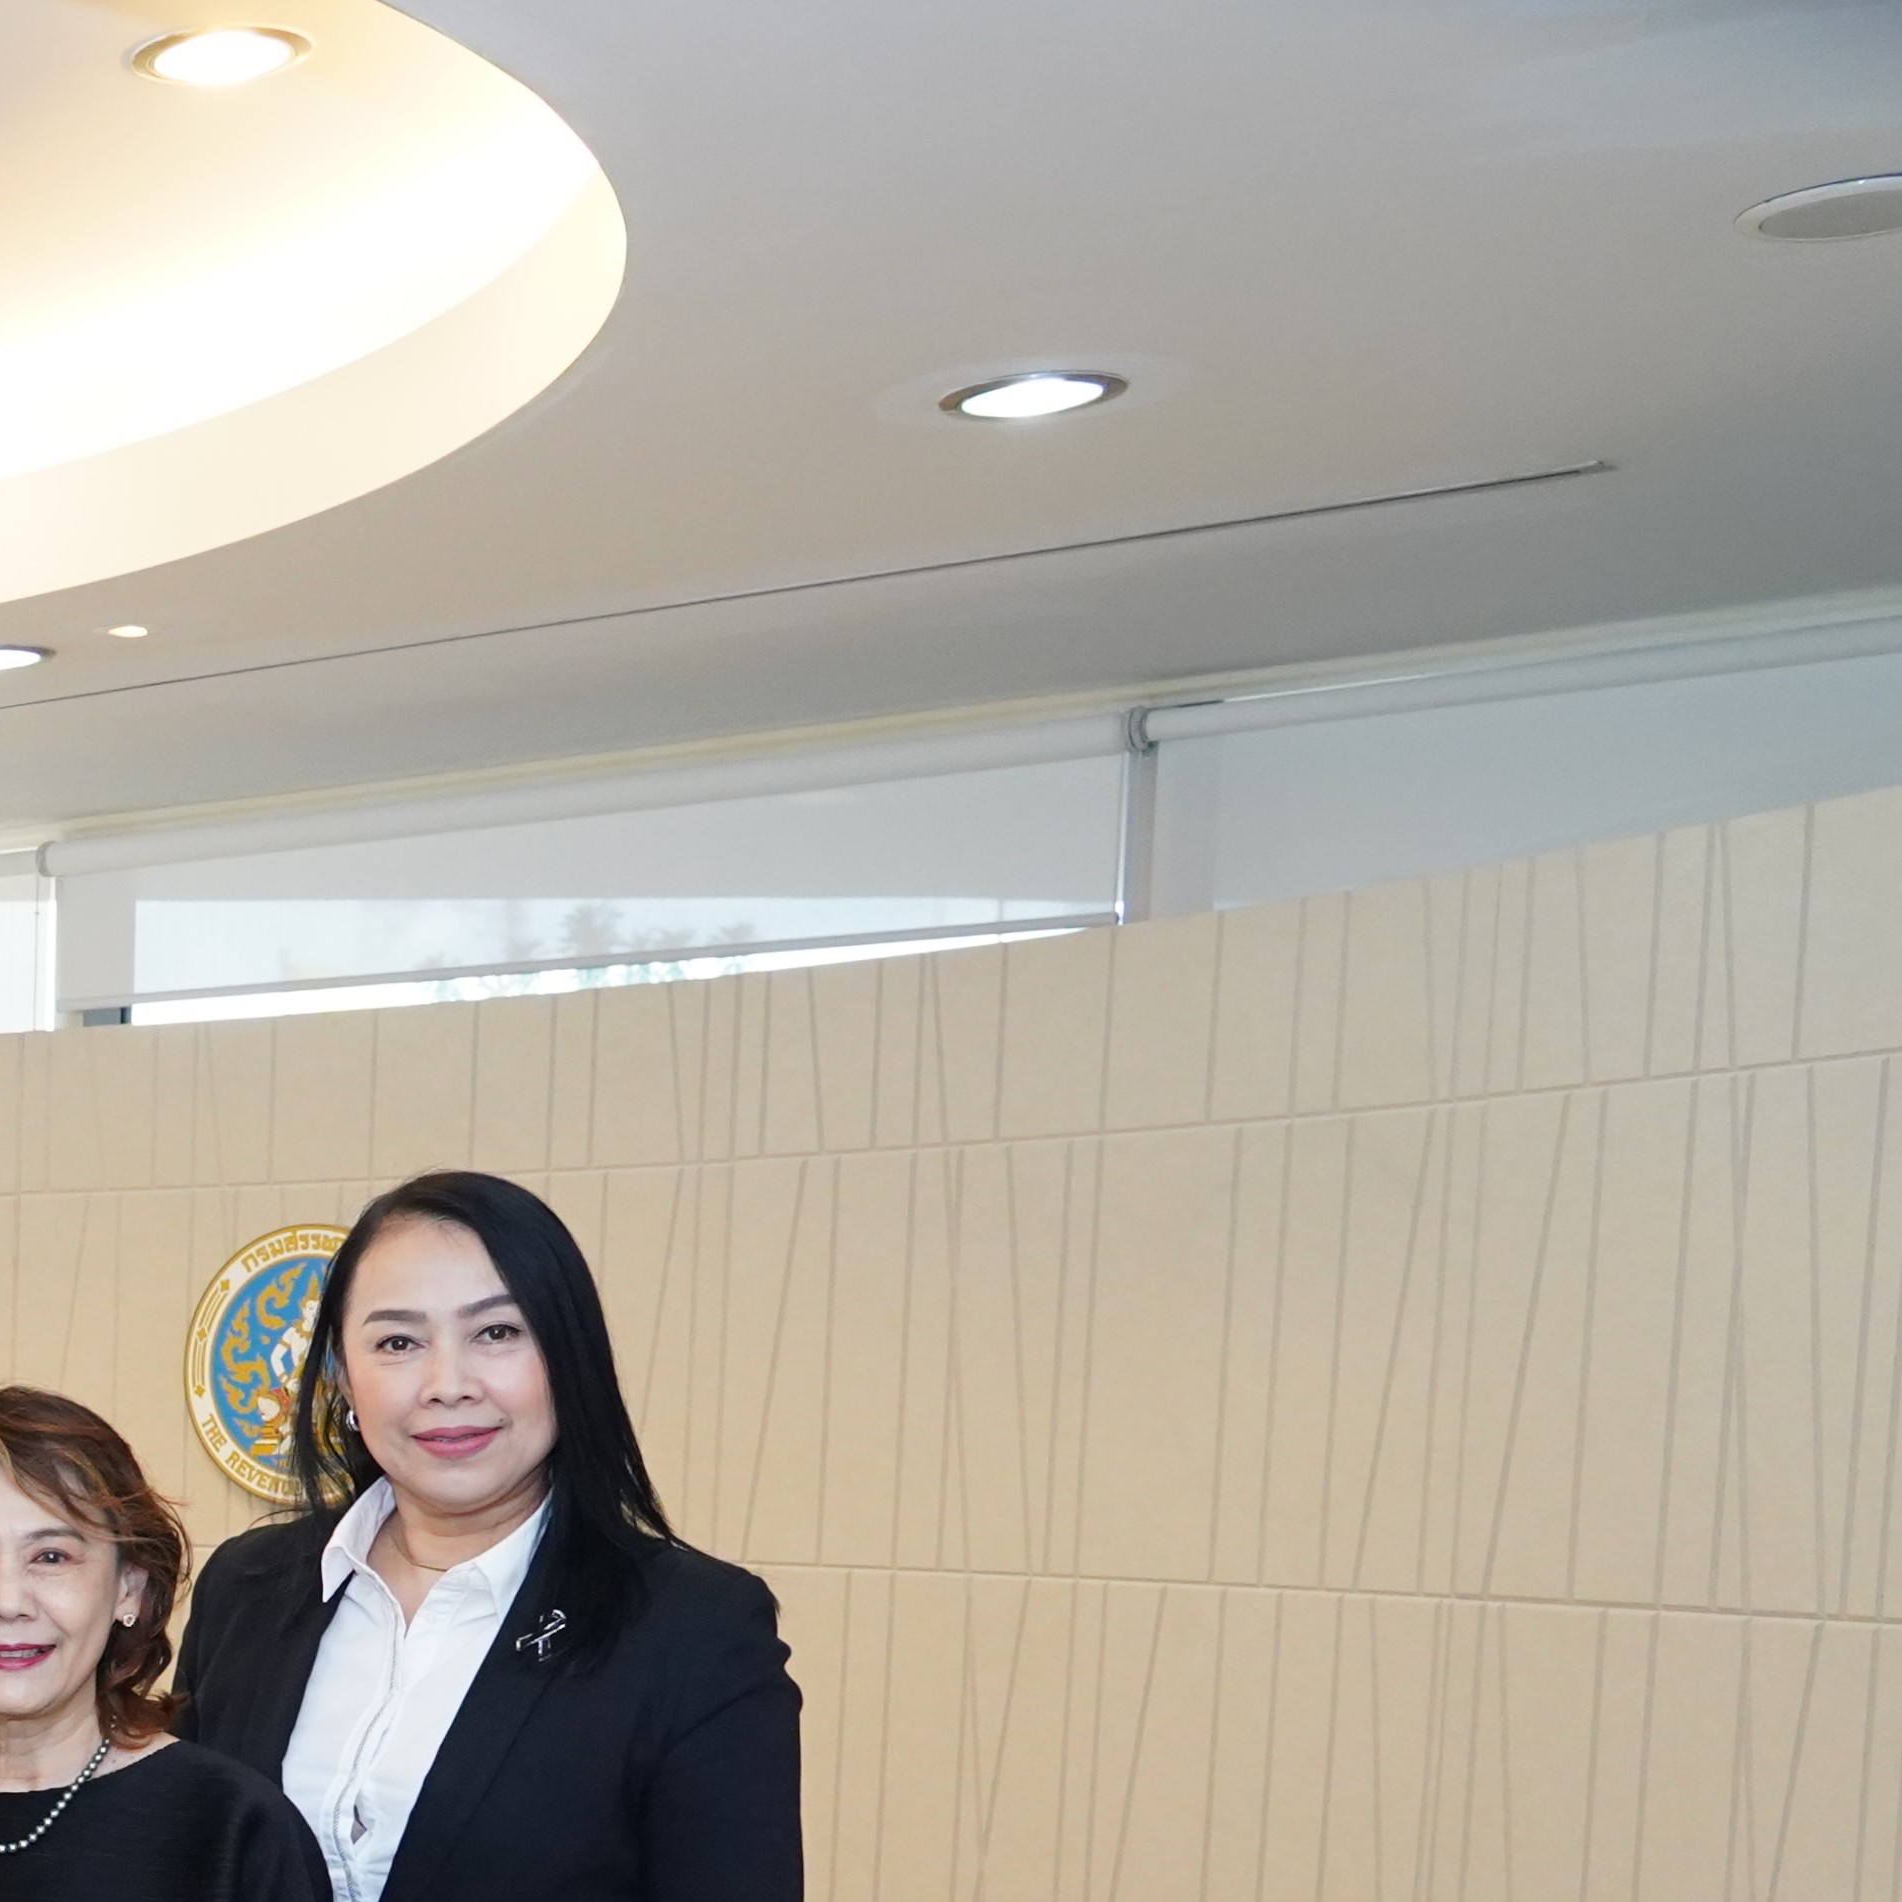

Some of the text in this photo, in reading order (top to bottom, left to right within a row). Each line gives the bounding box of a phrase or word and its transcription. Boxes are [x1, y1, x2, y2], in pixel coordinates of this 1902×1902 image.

[241, 1230, 344, 1273] กรมสรรพ
[201, 1412, 302, 1497] THE REVENU
